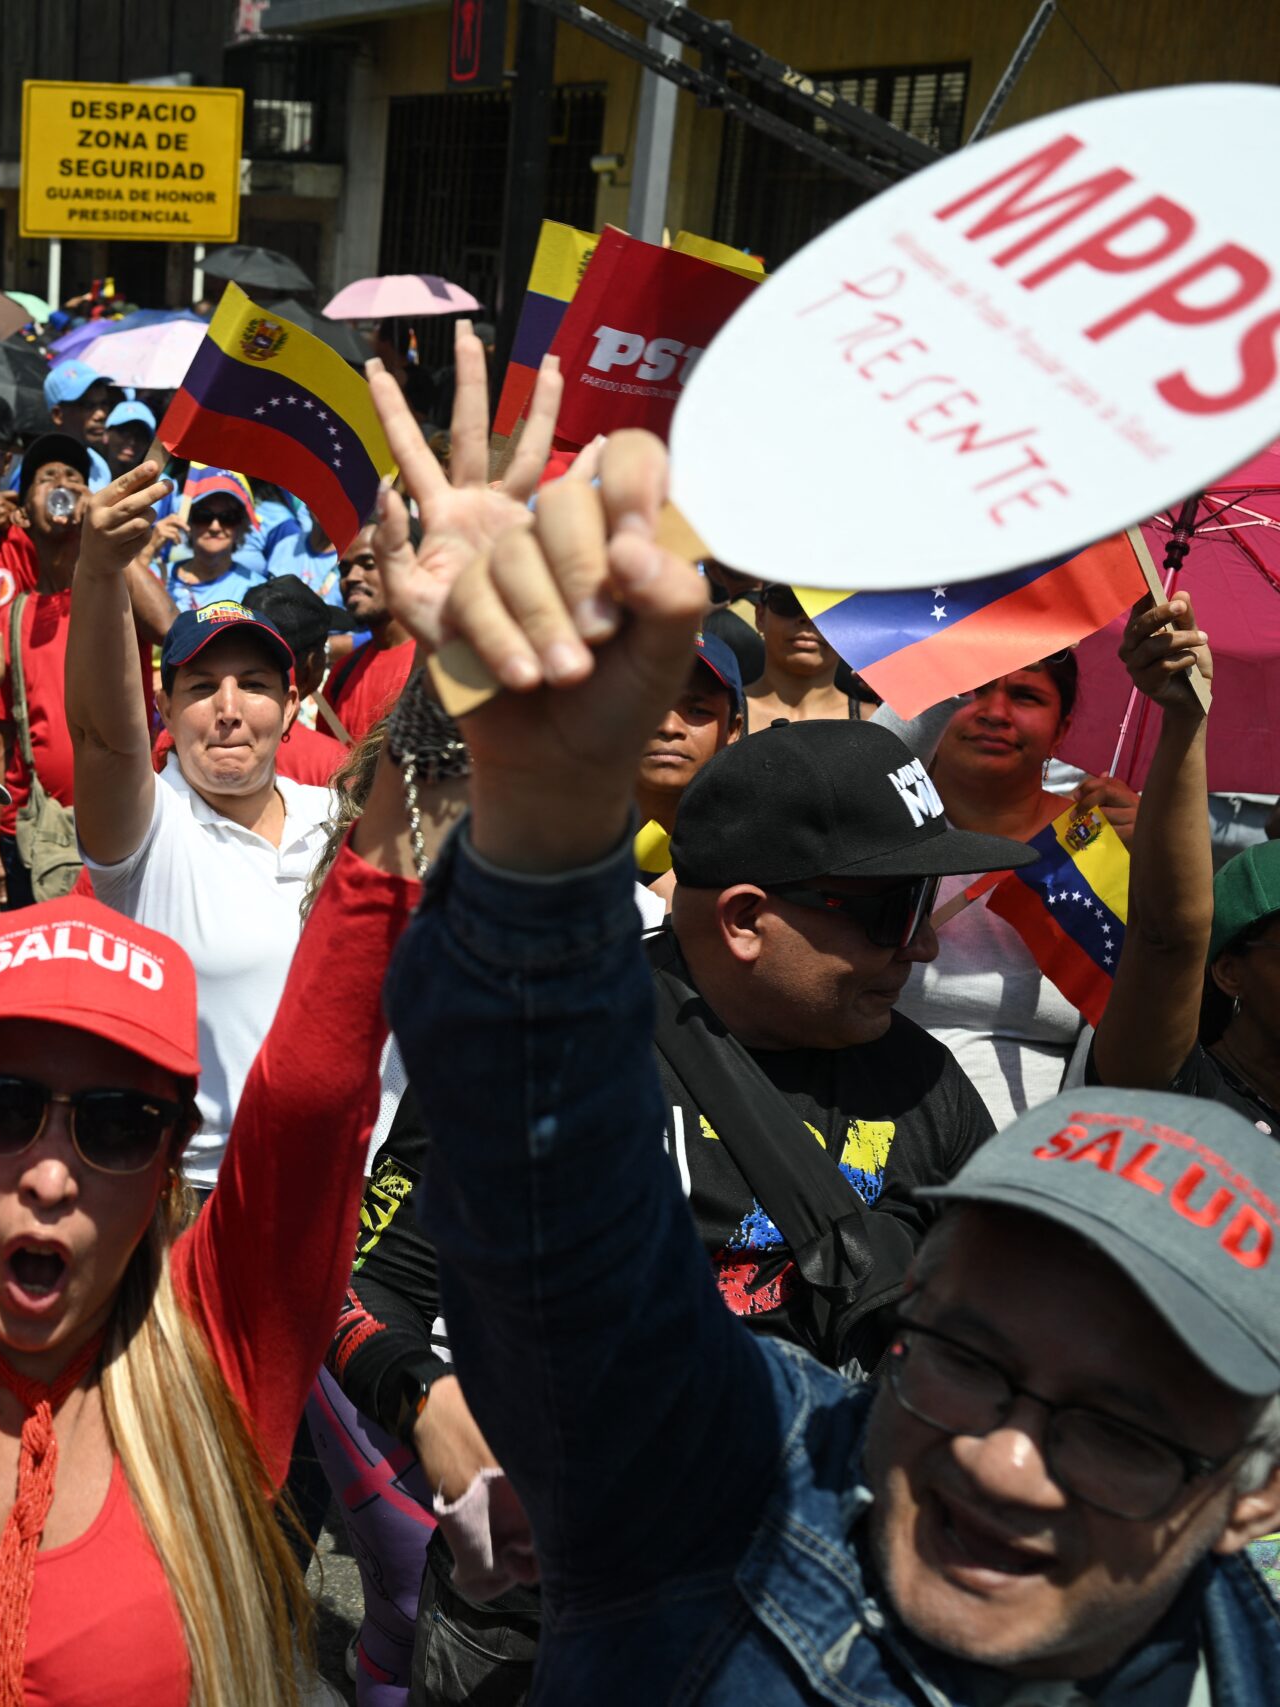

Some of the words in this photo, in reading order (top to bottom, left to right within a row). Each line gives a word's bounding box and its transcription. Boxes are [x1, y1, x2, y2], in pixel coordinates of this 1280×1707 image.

[71, 101, 197, 123] DESPACIO
[77, 129, 148, 149] ZONA
[157, 133, 188, 151] DE
[59, 158, 205, 180] SEGURIDAD
[46, 187, 124, 201] GUARDIA
[129, 190, 151, 202] DE
[155, 190, 217, 204] HONOR
[68, 208, 191, 224] PRESIDENCIAL
[933, 132, 1280, 418] MPPS
[795, 264, 1071, 528] PRESENTE
[32, 924, 49, 933] DEL
[52, 920, 85, 929] PODER
[87, 924, 128, 945] POPULAR
[1032, 1125, 1274, 1269] SALUD
